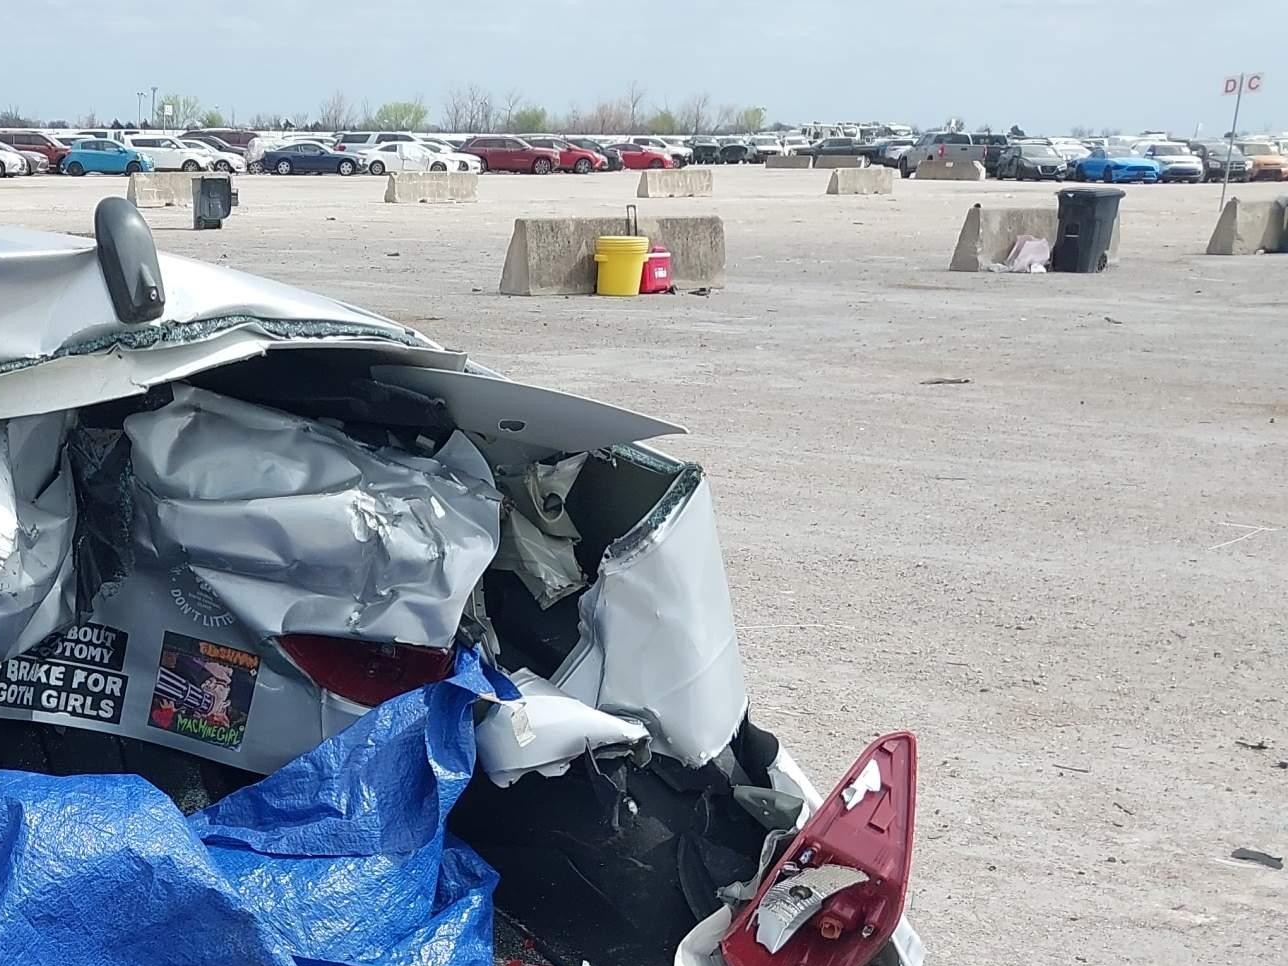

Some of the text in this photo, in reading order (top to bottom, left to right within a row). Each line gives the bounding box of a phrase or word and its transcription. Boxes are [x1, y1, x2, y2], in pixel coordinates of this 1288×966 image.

[1224, 79, 1237, 93] D
[1248, 75, 1261, 90] C
[170, 588, 202, 621] DON'T
[64, 625, 117, 649] BOUT
[7, 659, 123, 697] BRAKE FOR
[41, 689, 115, 719] GIRLS
